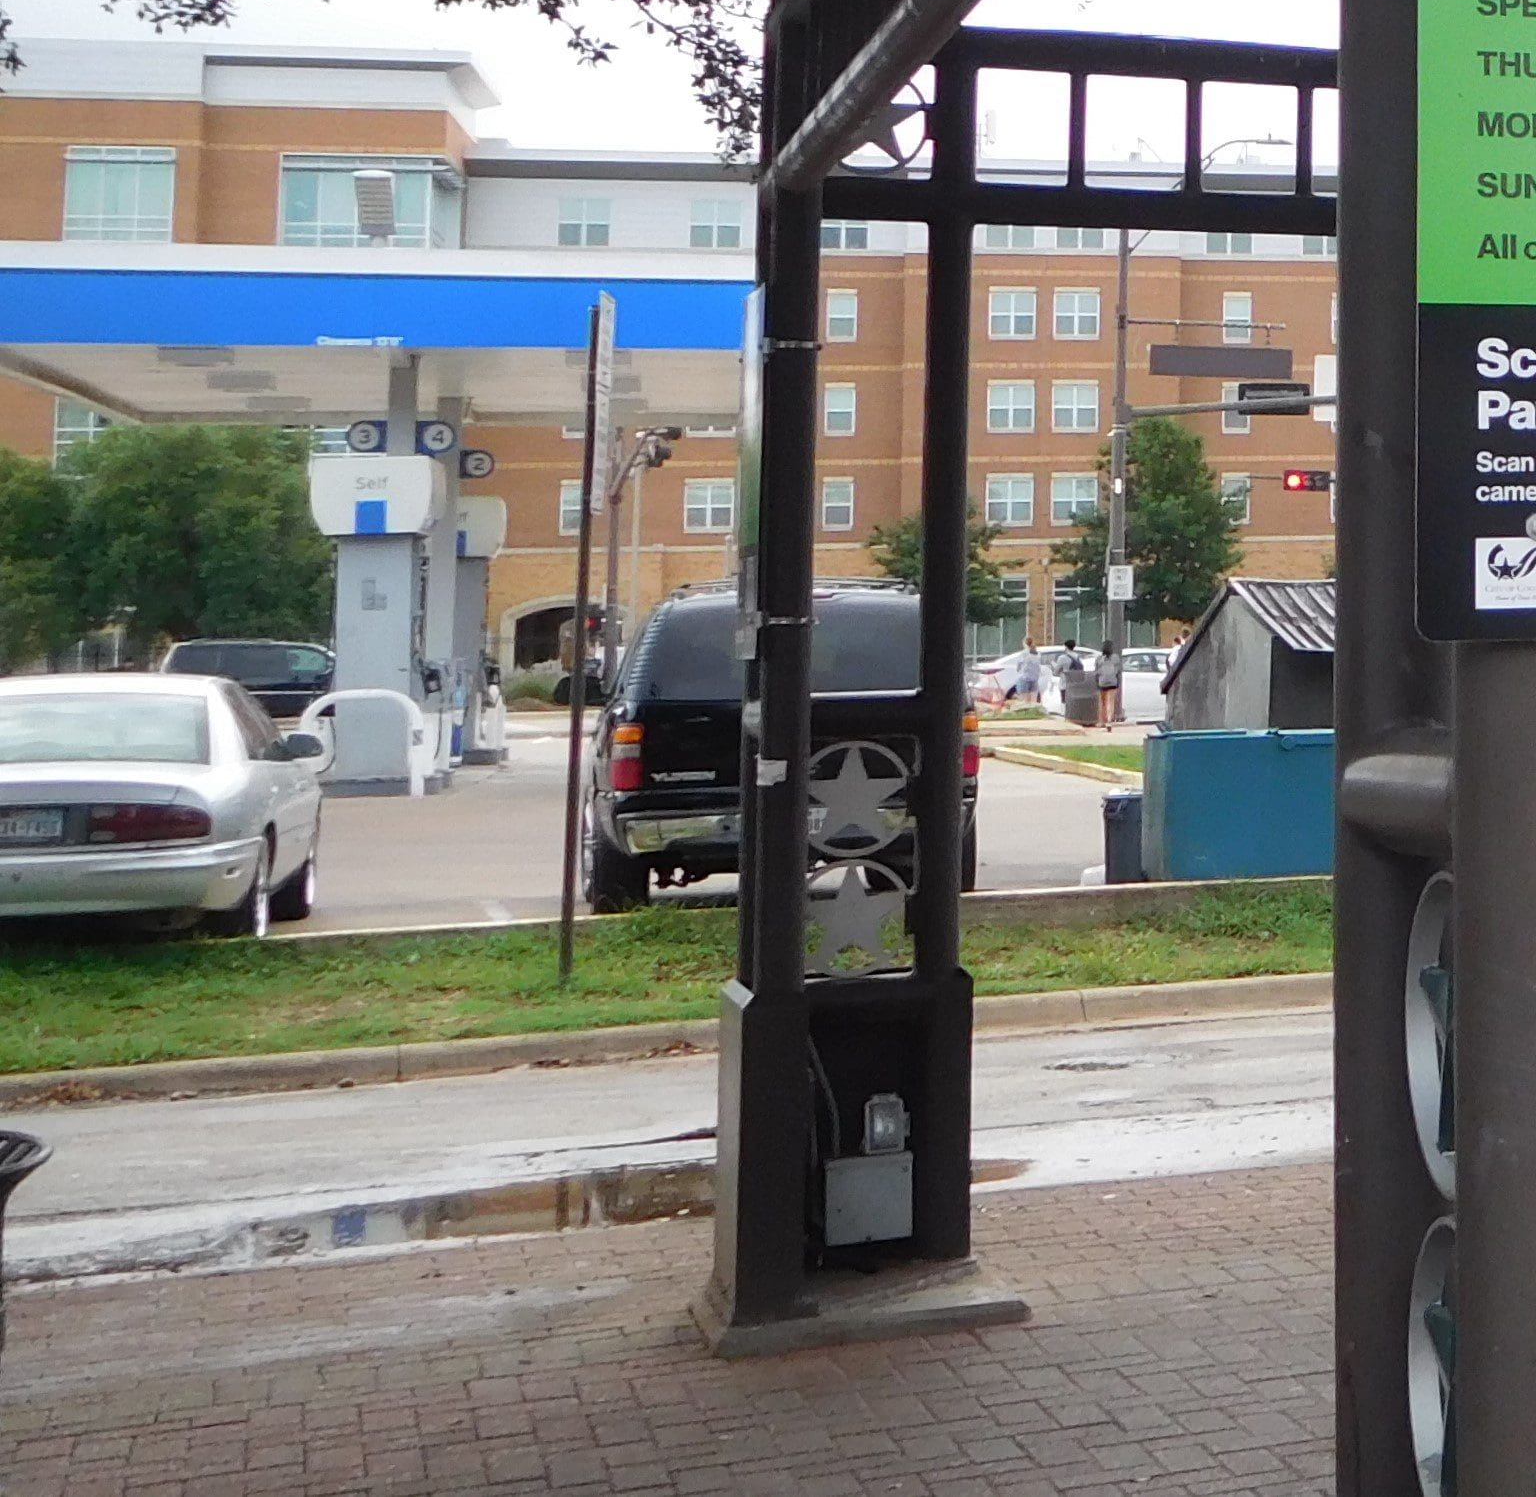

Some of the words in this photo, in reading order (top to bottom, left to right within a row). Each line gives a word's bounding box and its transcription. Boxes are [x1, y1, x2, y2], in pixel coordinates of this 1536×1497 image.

[1477, 234, 1519, 261] All
[1476, 451, 1534, 473] Scan
[356, 476, 389, 490] Self
